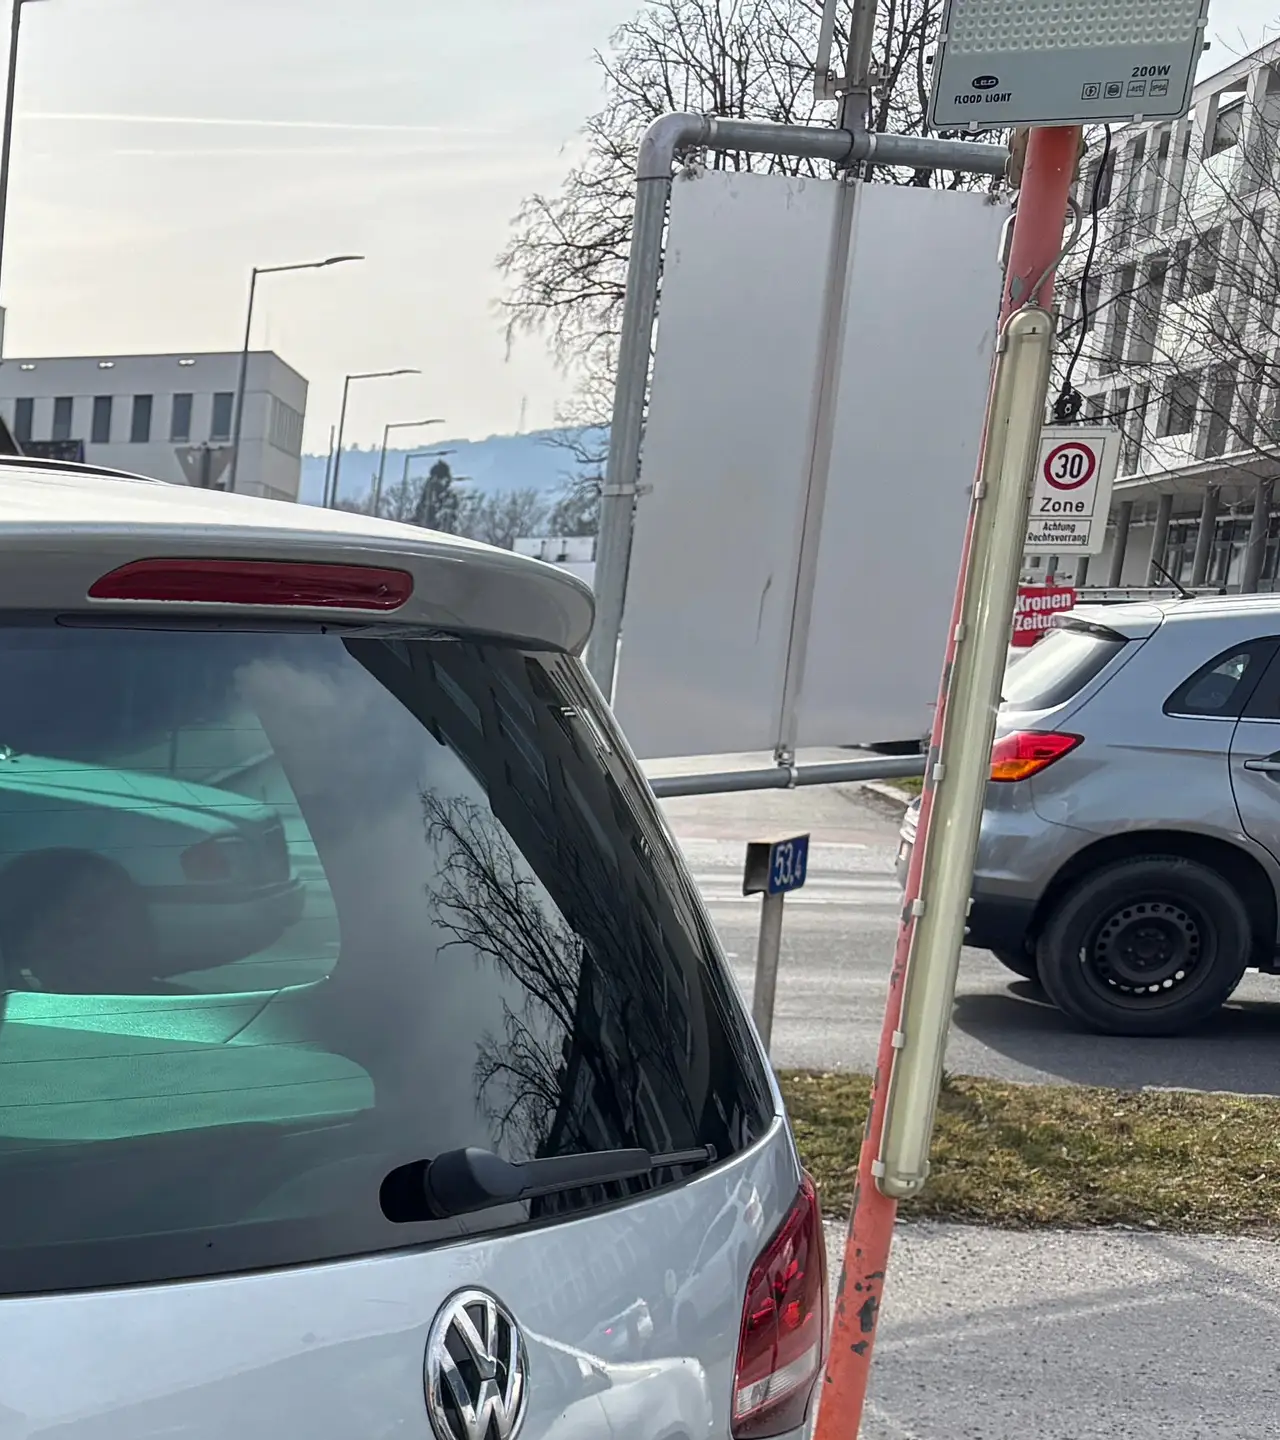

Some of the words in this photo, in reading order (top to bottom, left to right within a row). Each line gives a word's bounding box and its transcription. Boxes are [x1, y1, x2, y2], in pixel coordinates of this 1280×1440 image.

[1131, 65, 1171, 77] 200W
[973, 78, 998, 88] LED
[954, 94, 982, 105] FLOOD
[985, 92, 1012, 103] LIGHT
[1054, 453, 1084, 480] 30
[1040, 497, 1086, 513] Zone
[1042, 520, 1077, 534] Achtung
[1027, 532, 1089, 546] Rechtsvorrang
[1015, 593, 1072, 612] Kronen
